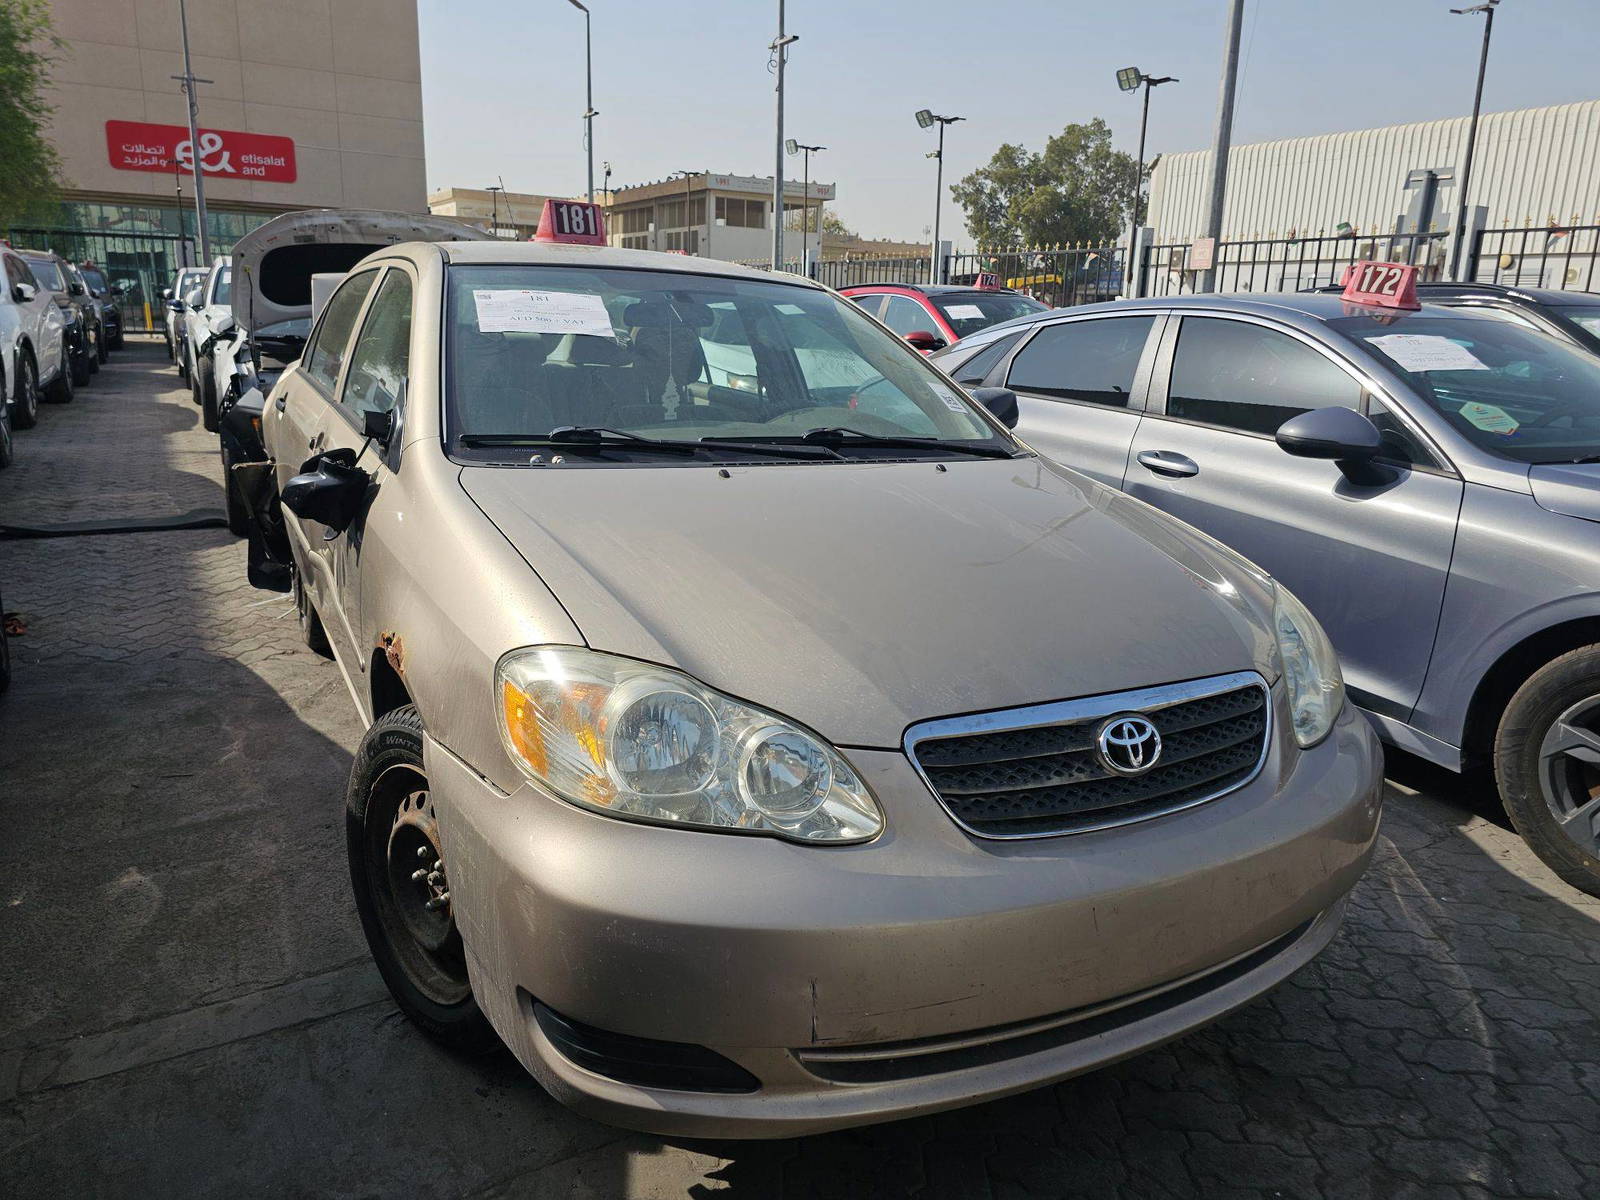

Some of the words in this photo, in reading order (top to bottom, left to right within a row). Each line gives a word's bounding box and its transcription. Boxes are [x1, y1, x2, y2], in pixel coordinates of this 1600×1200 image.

[122, 143, 166, 155] اتصالات
[241, 154, 285, 167] etisalat
[242, 165, 265, 176] and
[559, 204, 596, 235] 181
[1359, 265, 1403, 296] 172
[386, 735, 422, 752] WINTE
